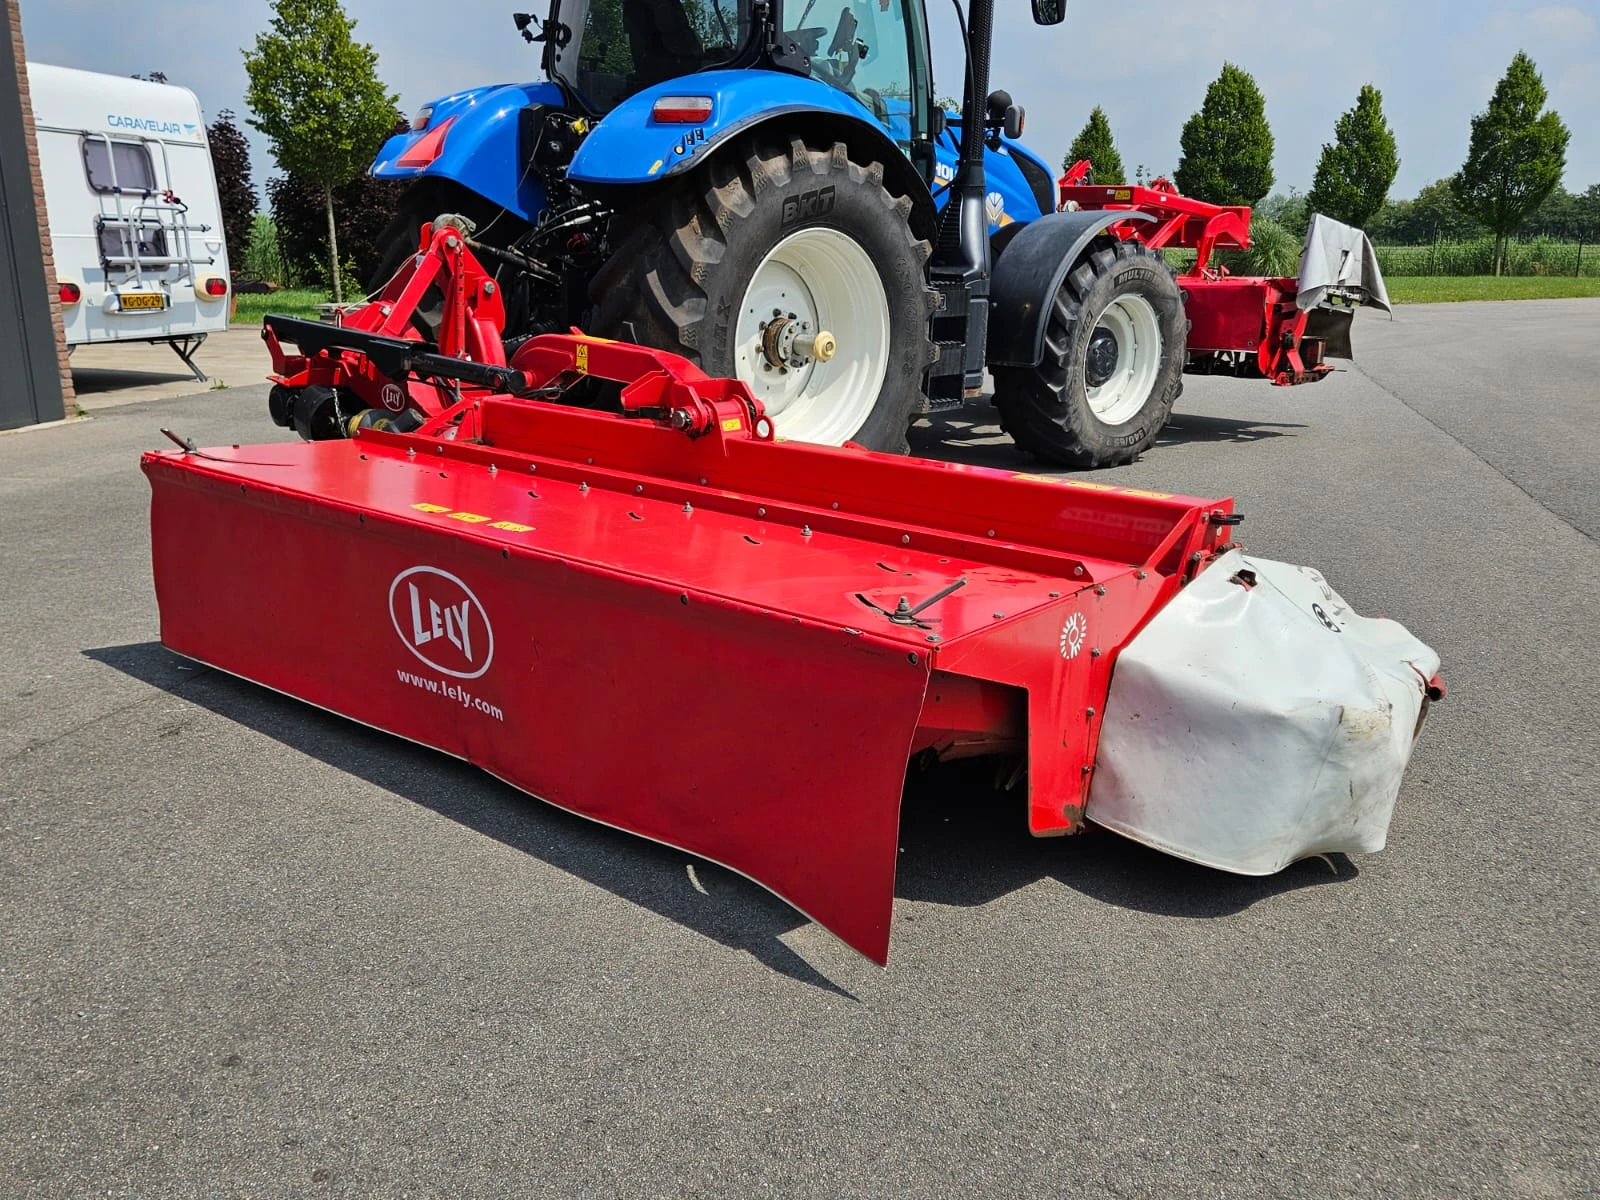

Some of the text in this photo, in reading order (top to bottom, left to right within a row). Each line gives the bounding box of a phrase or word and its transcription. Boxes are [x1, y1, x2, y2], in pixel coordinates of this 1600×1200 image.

[107, 114, 181, 134] CARAVELAIR
[783, 186, 835, 224] BKT
[408, 581, 473, 663] LELY
[396, 669, 504, 722] www.lely.com
